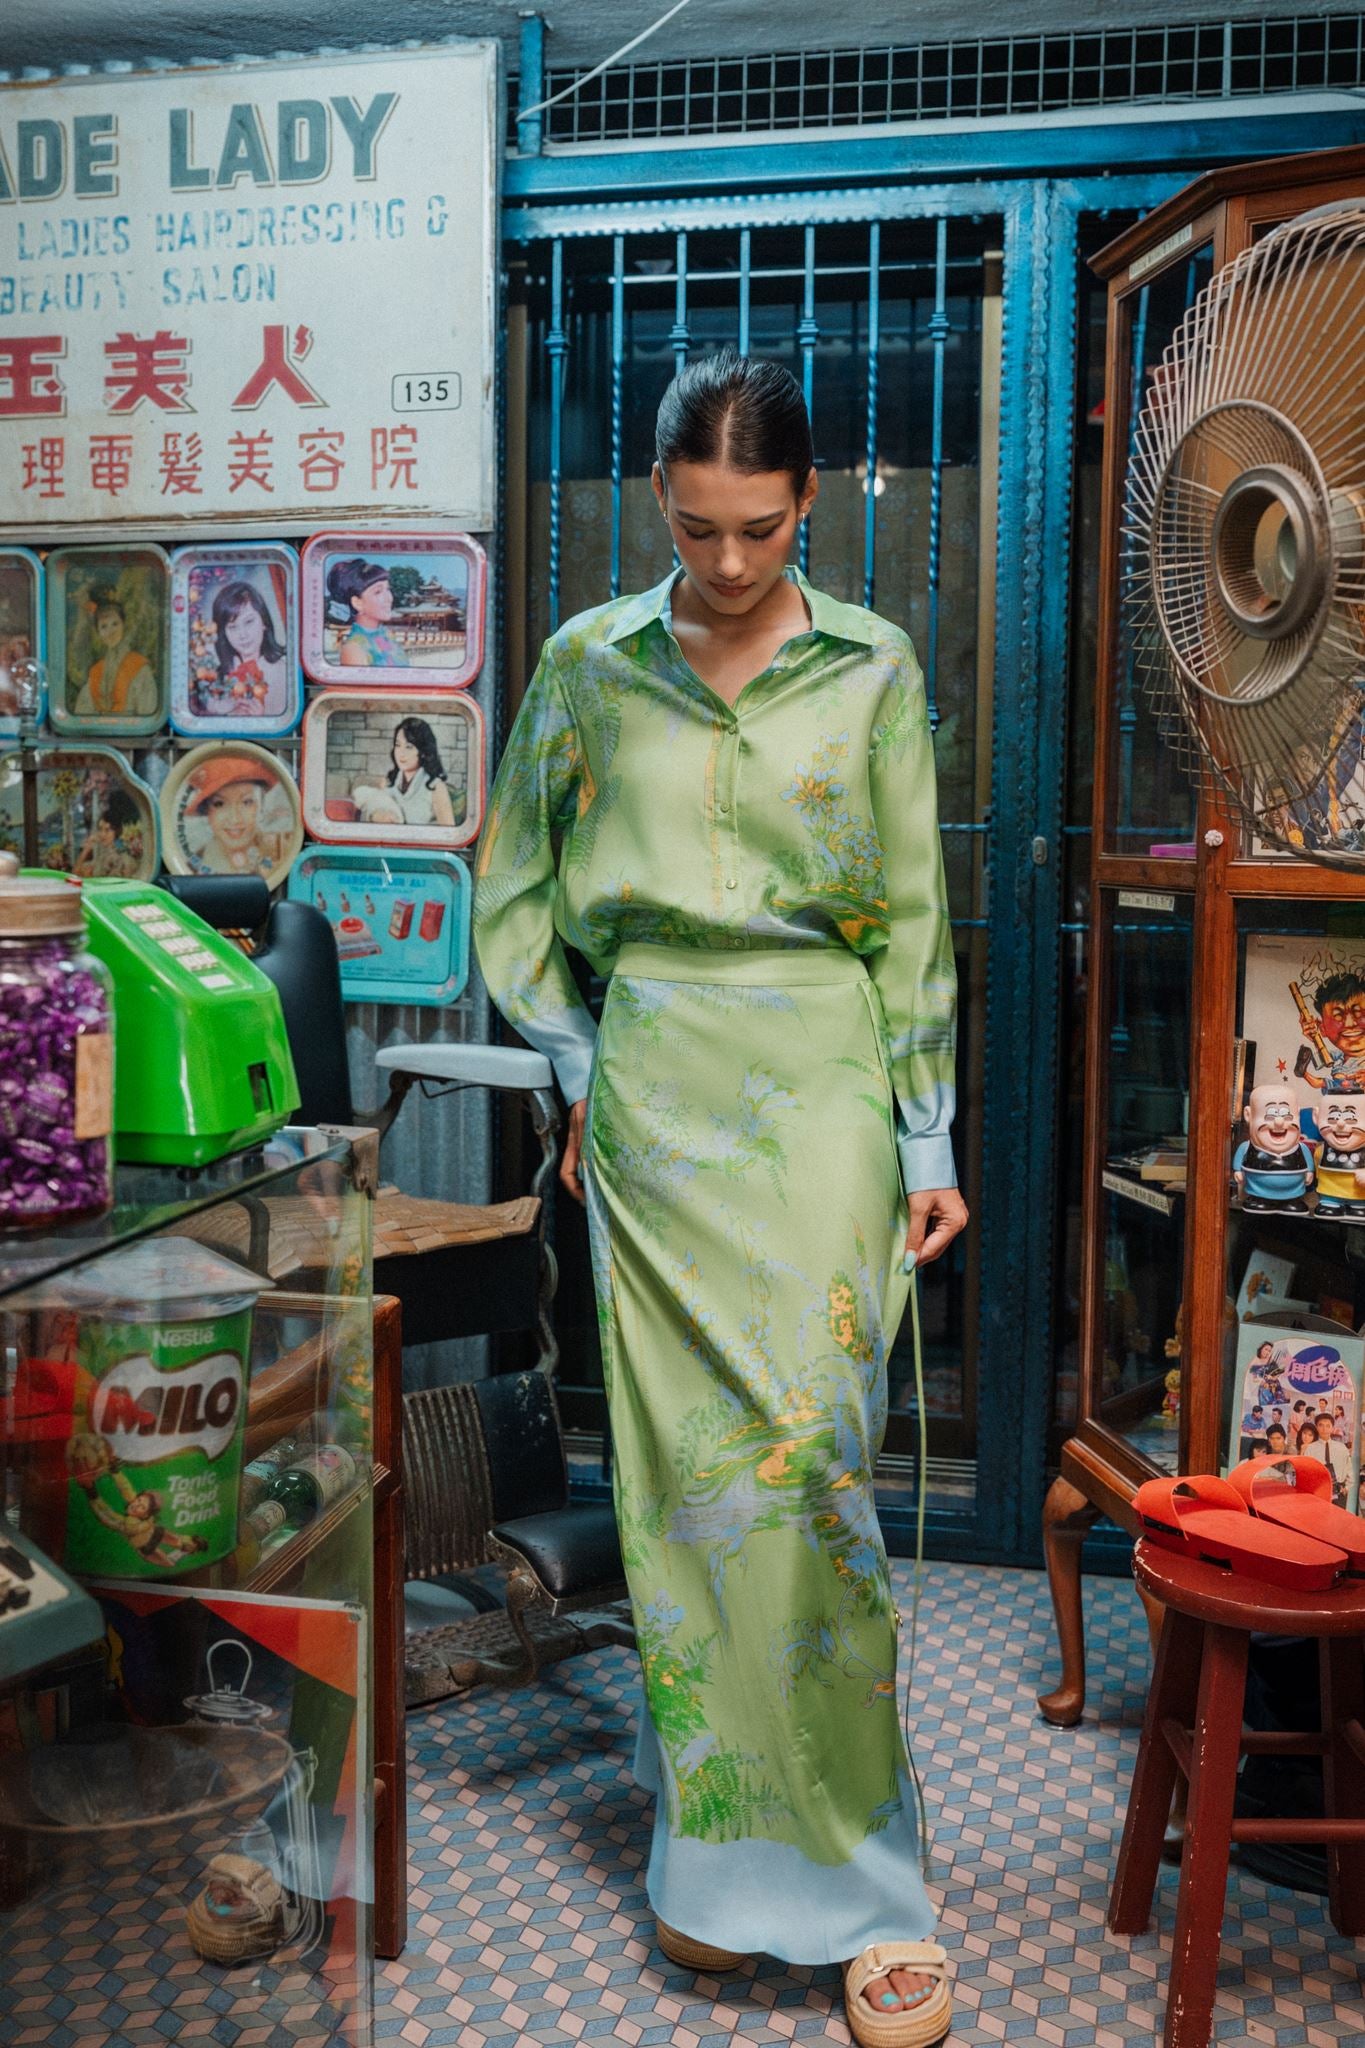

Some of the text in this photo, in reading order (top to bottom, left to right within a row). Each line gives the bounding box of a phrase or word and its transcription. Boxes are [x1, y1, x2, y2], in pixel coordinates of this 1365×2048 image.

[0, 92, 401, 206] DE LADY
[18, 215, 131, 261] LADIES
[0, 262, 276, 316] BEAUTY SALON
[405, 380, 449, 403] 135
[21, 424, 419, 500] 理電髮美容院
[101, 1377, 238, 1436] MILO
[167, 1470, 217, 1493] Tonic
[171, 1484, 219, 1510] Food
[174, 1501, 220, 1528] Drink
